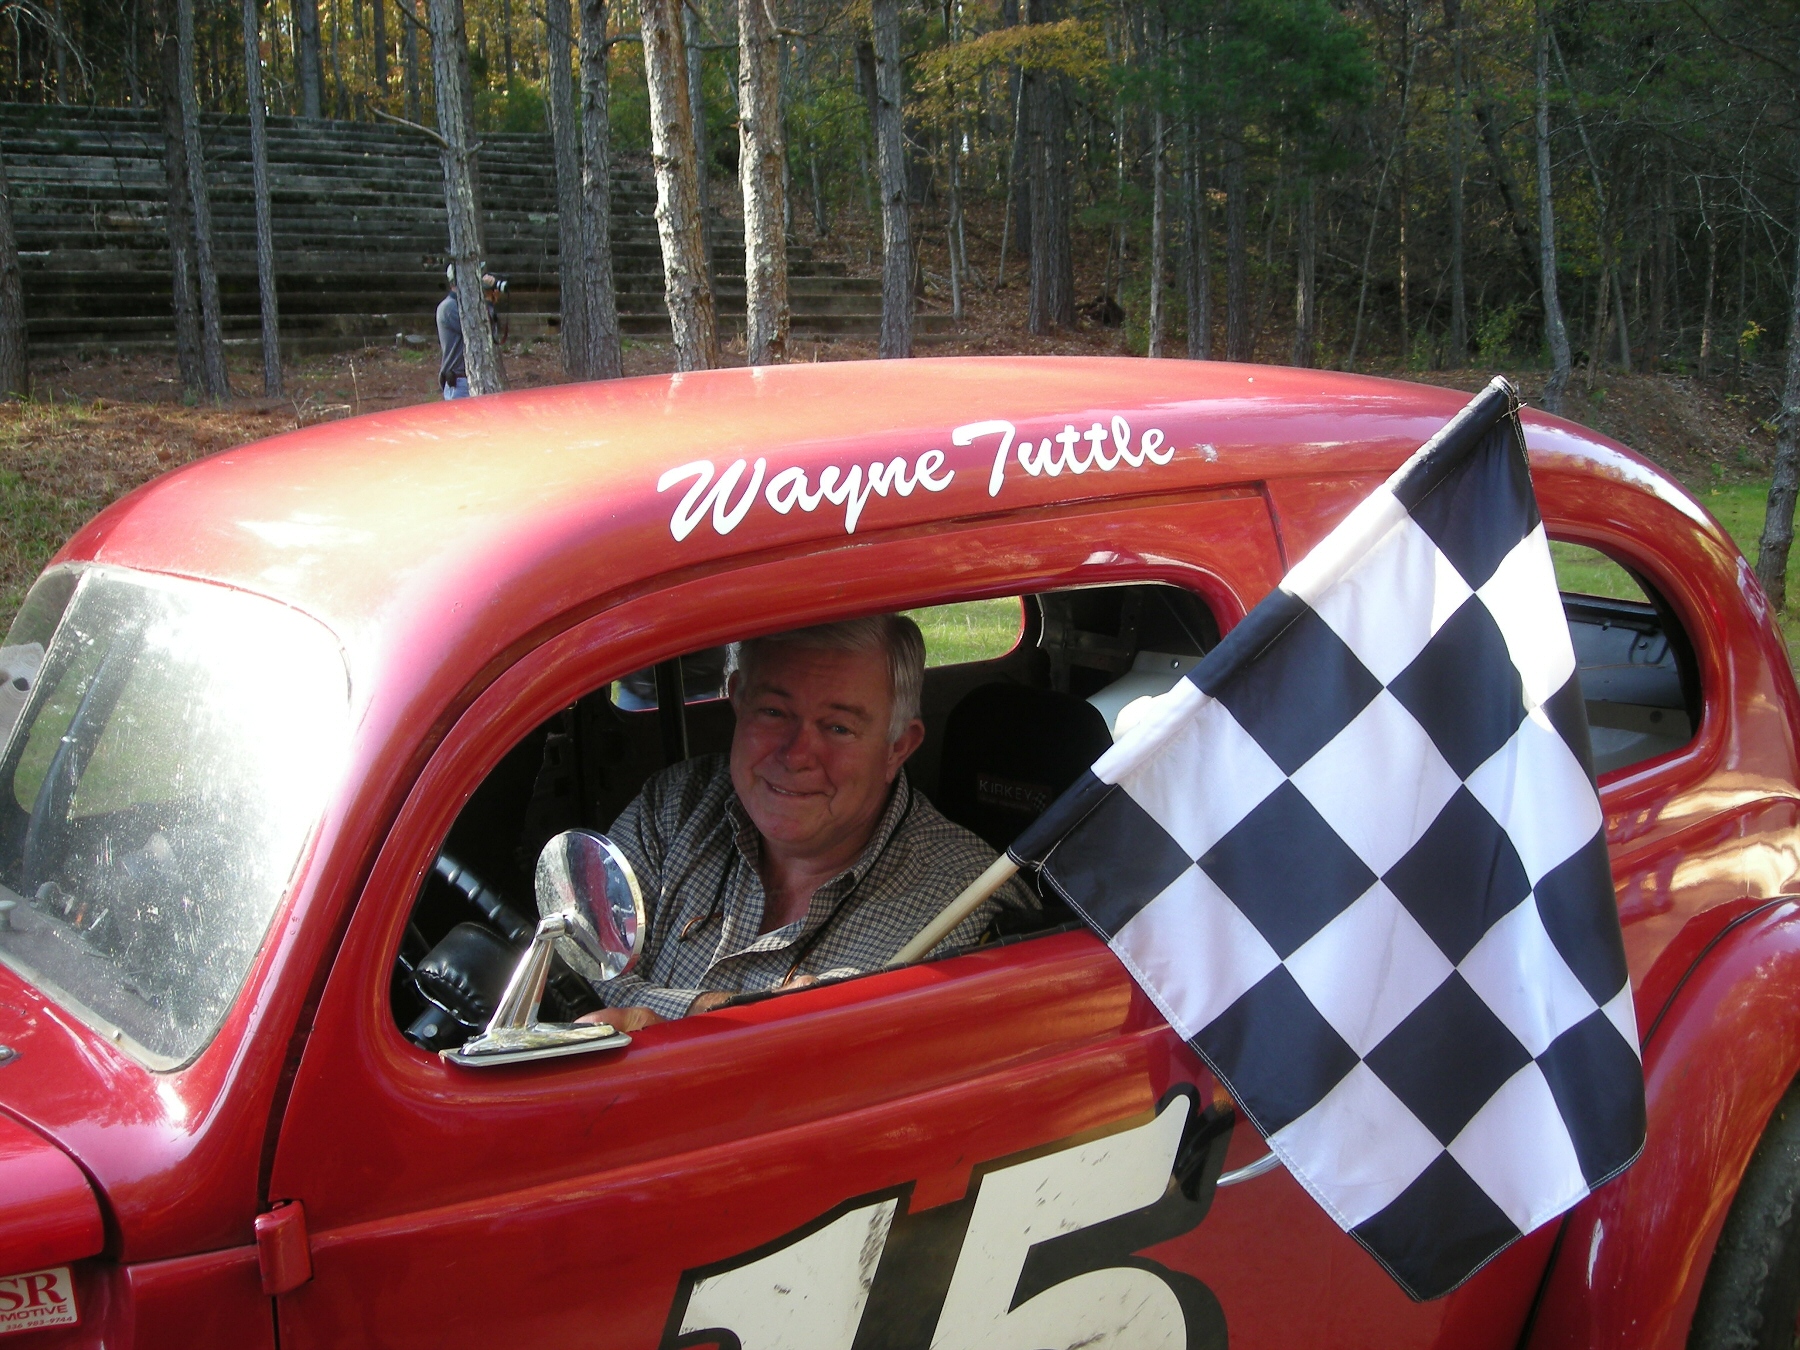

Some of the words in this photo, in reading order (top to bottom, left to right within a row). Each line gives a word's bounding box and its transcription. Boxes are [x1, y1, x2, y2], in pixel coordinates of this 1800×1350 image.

[657, 449, 955, 542] Wayne
[952, 415, 1176, 497] Tuttle
[979, 779, 1032, 802] KIRKEY
[672, 1090, 1194, 1350] 15
